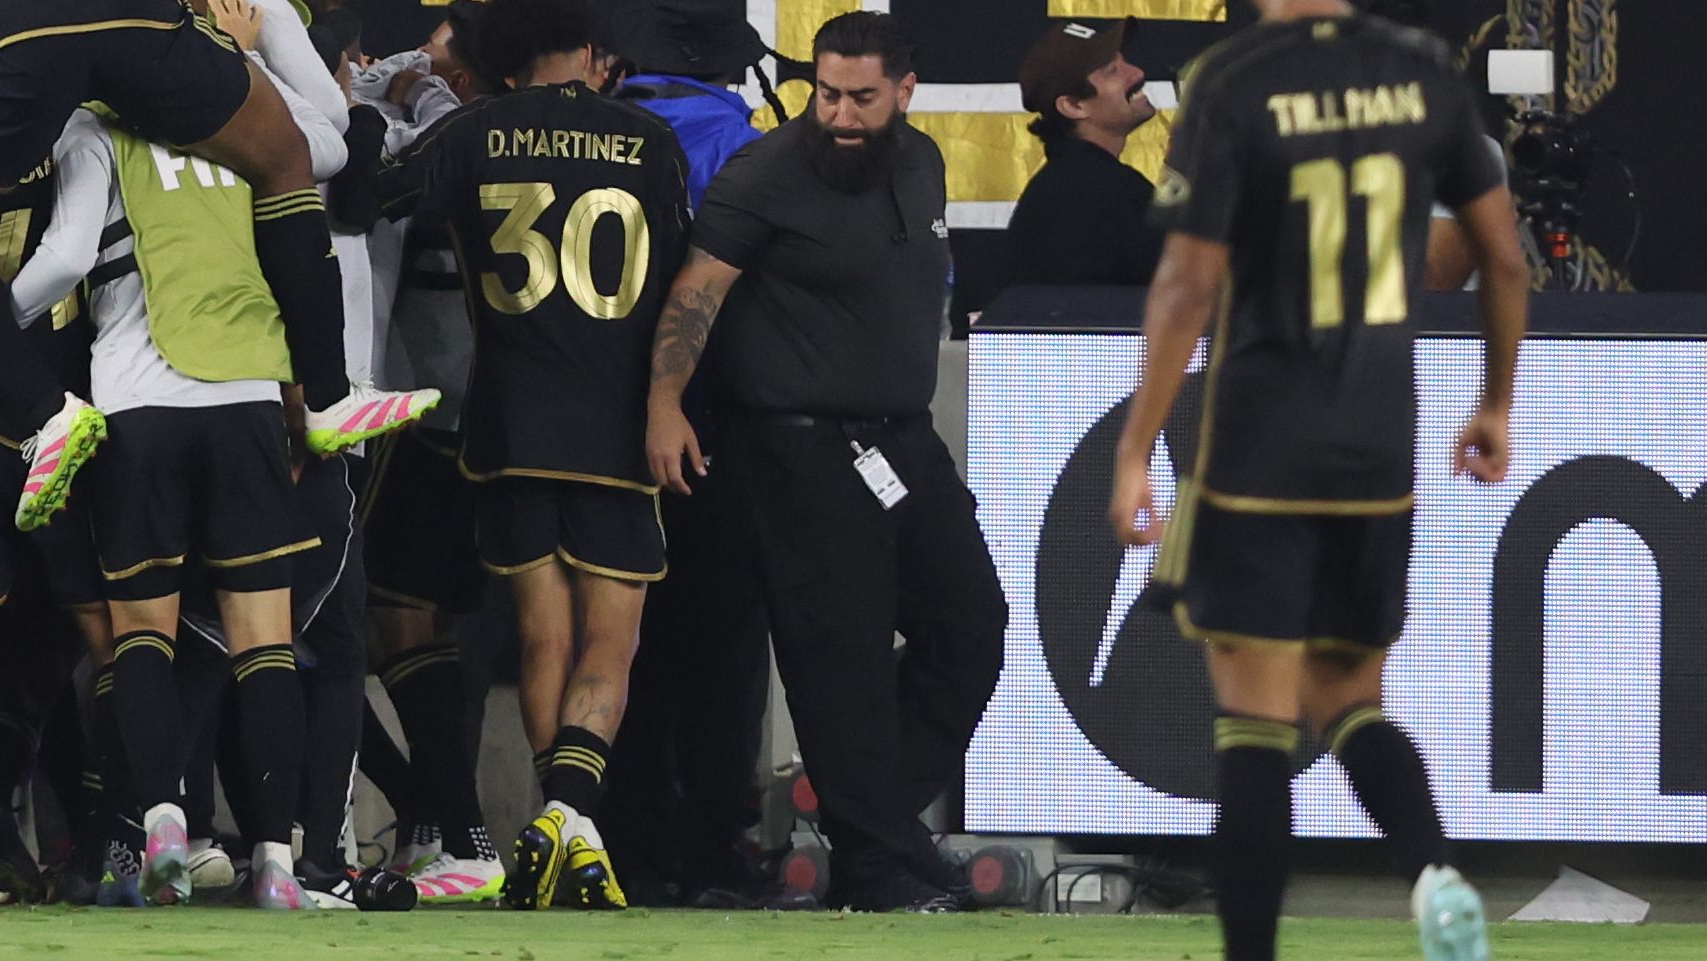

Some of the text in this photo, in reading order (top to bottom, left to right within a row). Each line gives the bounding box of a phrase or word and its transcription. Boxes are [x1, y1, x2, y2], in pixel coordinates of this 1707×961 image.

[488, 127, 645, 166] D.MARTINEZ
[1267, 81, 1426, 137] TILLMAN
[479, 181, 650, 320] 30
[1290, 151, 1407, 329] 11
